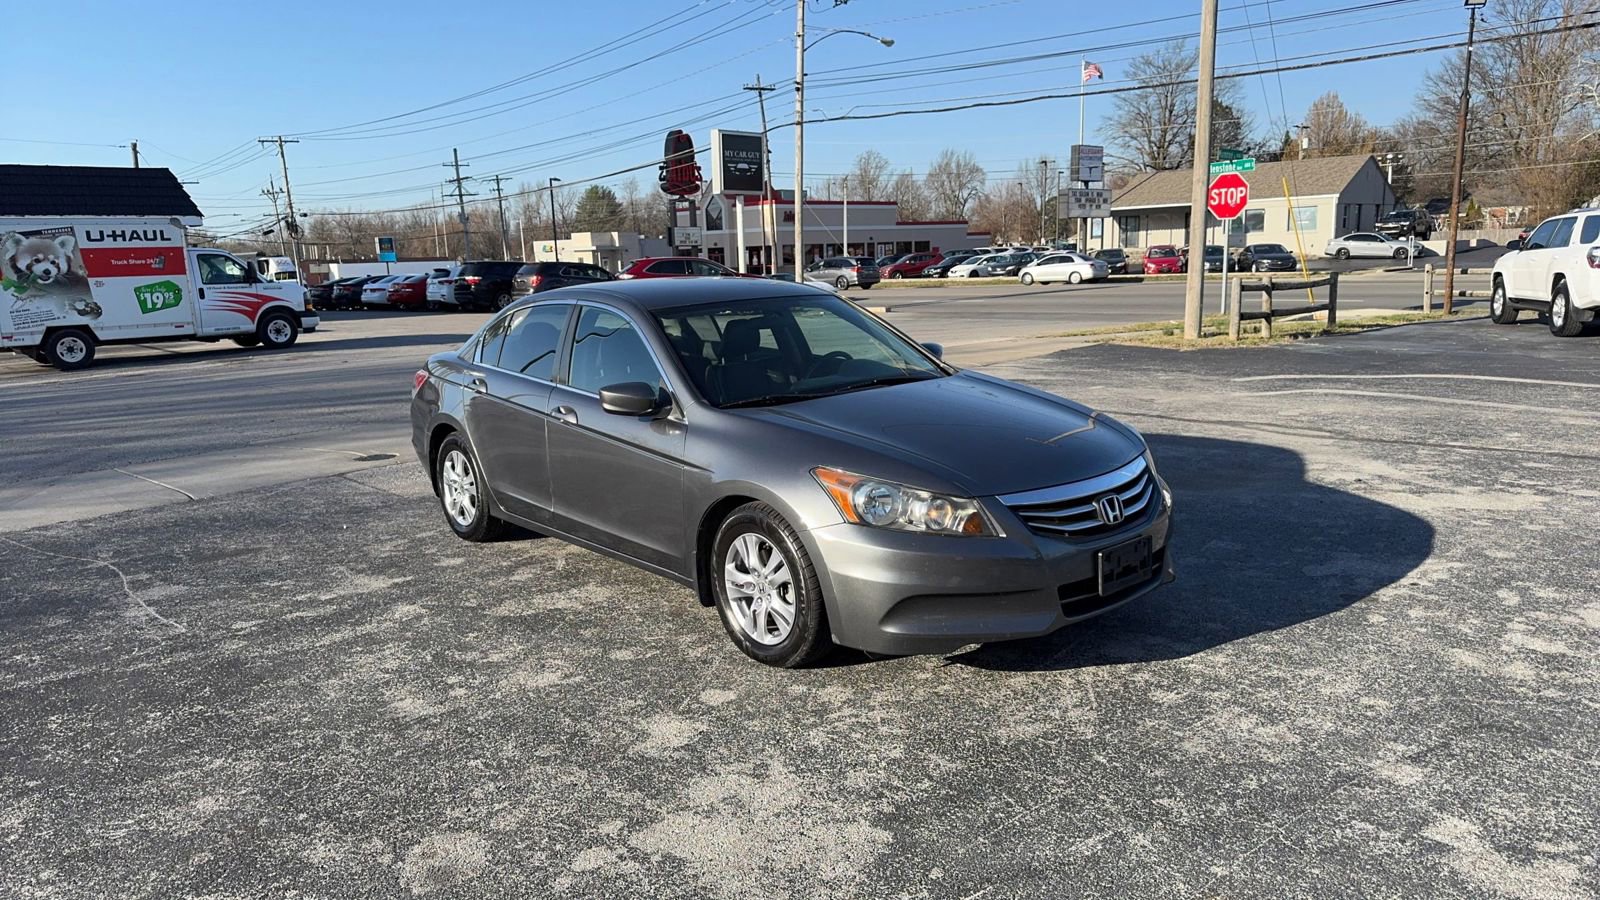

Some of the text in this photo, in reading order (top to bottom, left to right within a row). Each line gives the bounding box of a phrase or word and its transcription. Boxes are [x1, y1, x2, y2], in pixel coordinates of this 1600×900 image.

[1210, 164, 1236, 173] lenstone
[1210, 187, 1246, 205] STOP
[85, 229, 172, 242] U-HAUL
